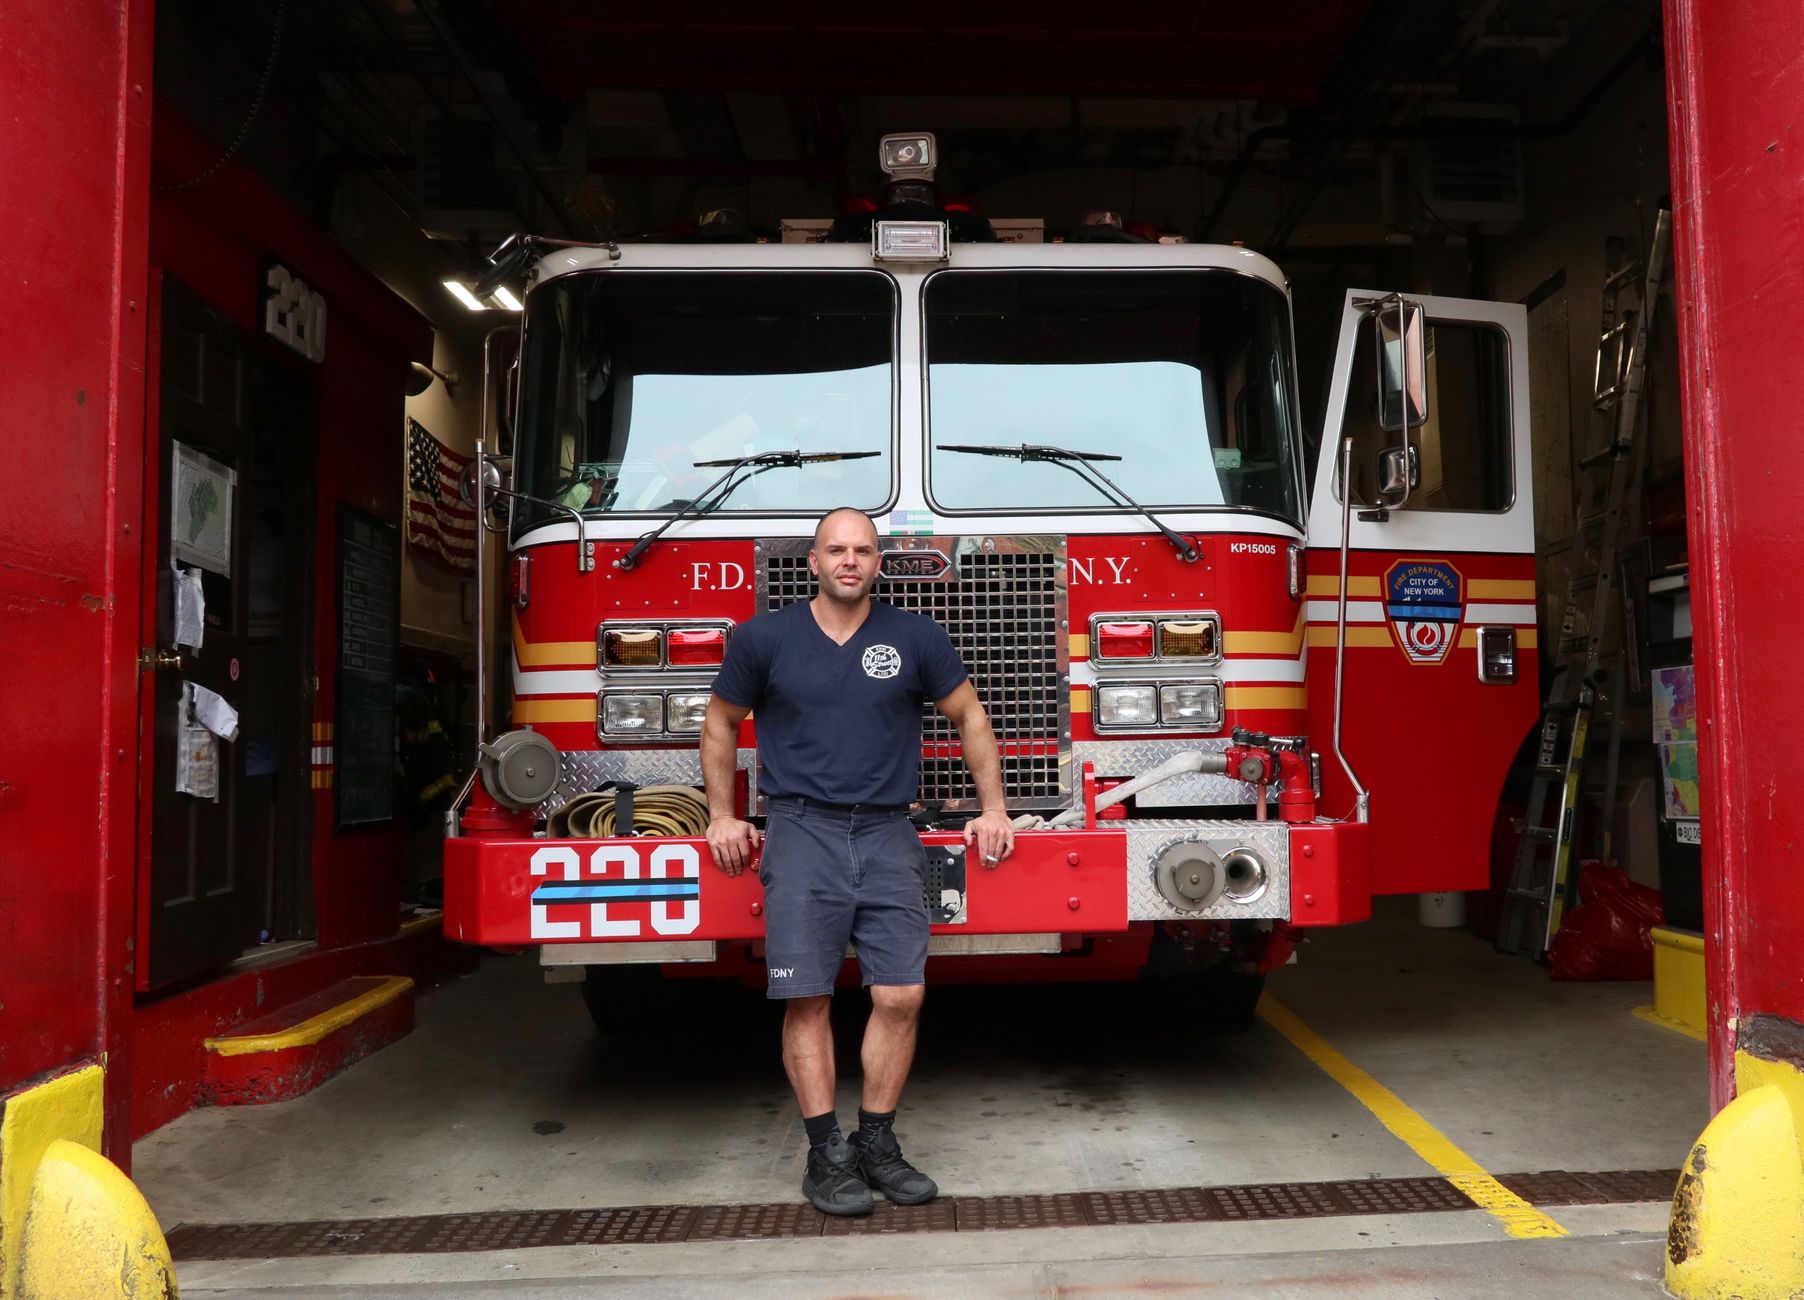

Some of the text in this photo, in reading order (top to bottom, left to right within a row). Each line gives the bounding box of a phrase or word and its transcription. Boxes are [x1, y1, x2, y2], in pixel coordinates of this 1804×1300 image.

[265, 262, 328, 364] 220
[1230, 543, 1276, 554] KP15005
[886, 559, 934, 570] KME
[1068, 556, 1132, 585] N.Y.
[690, 562, 753, 591] F.D.
[1394, 566, 1455, 590] FIRE DEPARTMENT
[1409, 578, 1438, 586] CITY OF
[1404, 587, 1444, 595] NEW YORK
[530, 843, 701, 939] 220
[769, 967, 794, 978] FDNY
